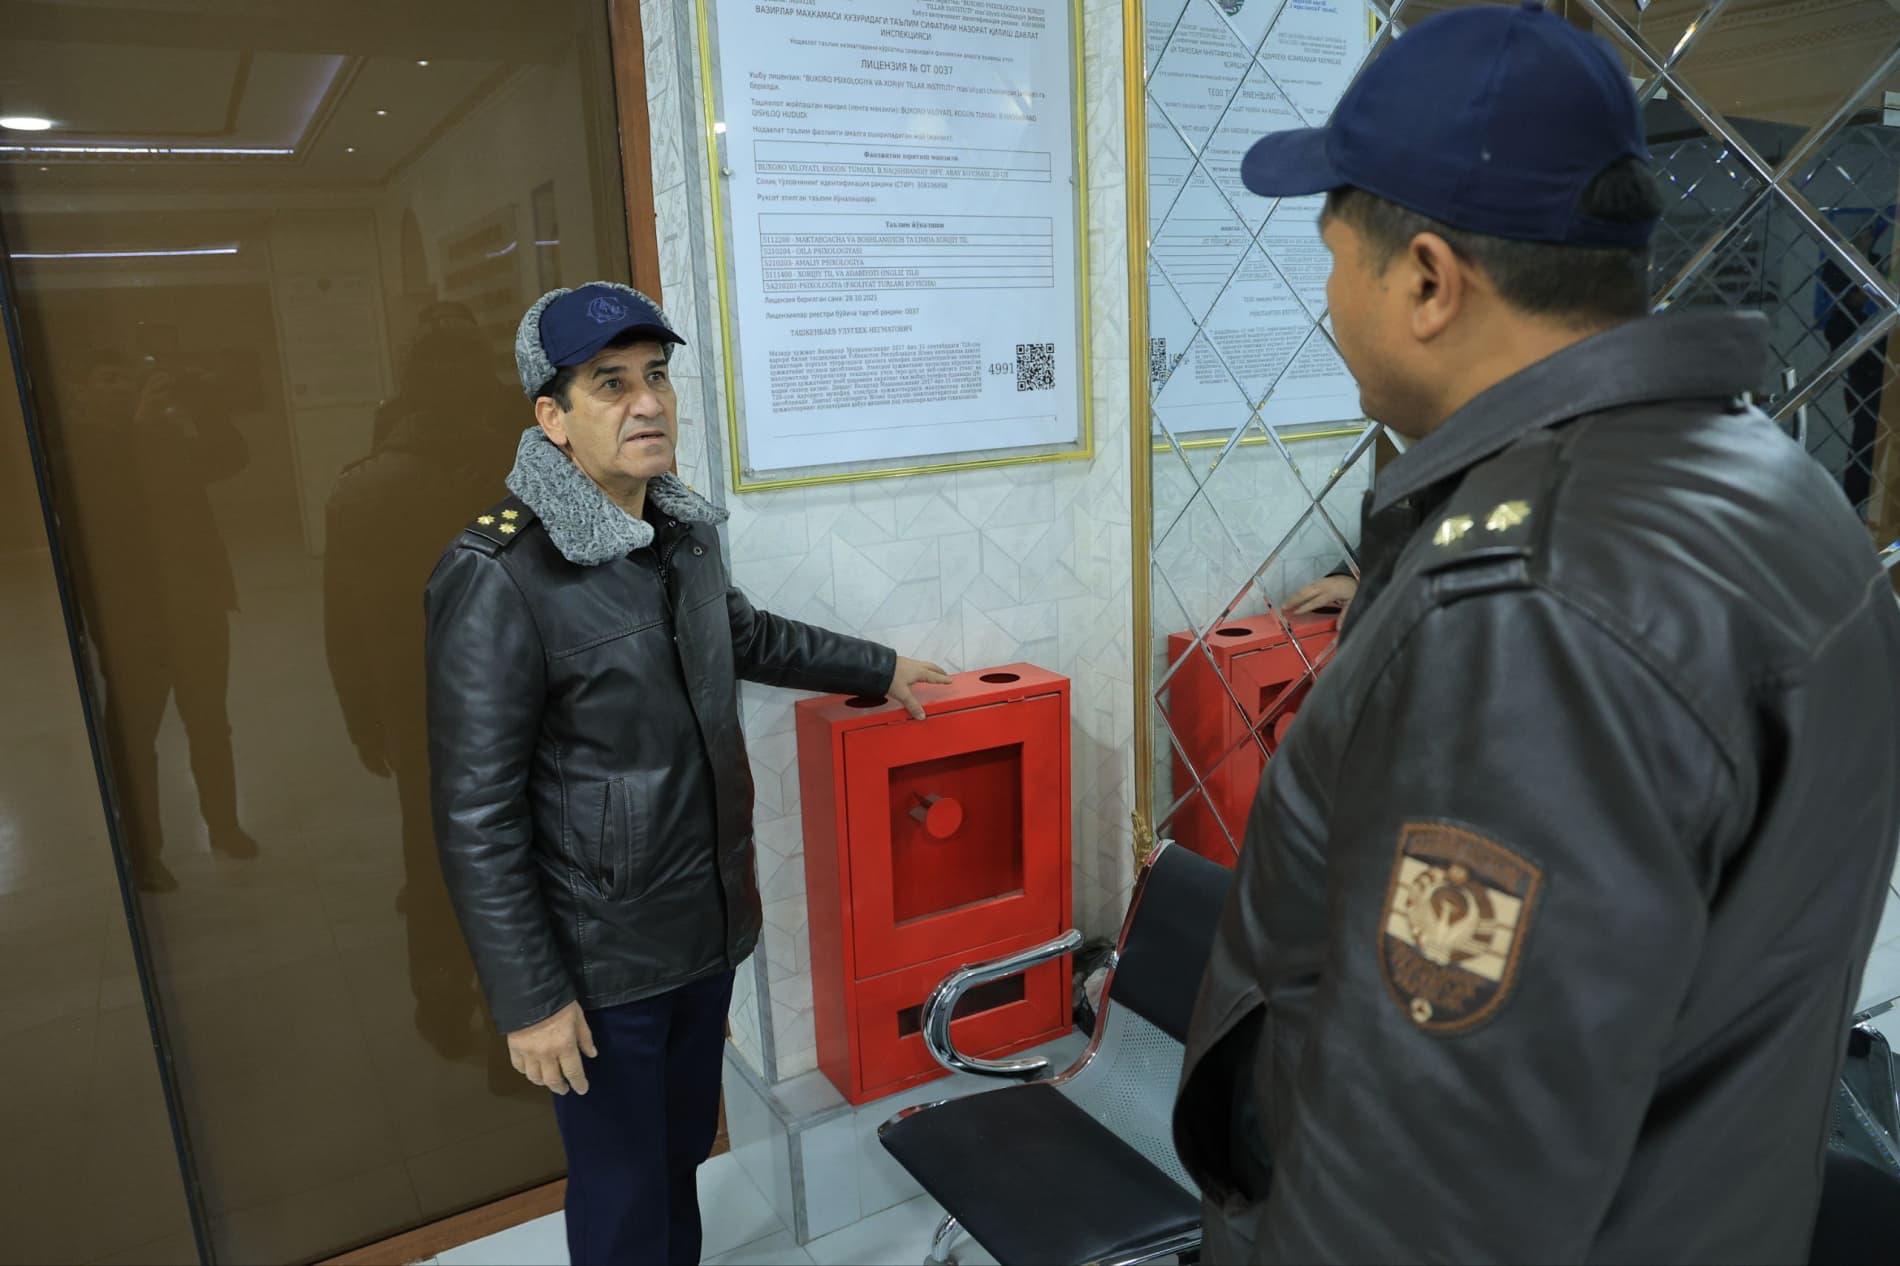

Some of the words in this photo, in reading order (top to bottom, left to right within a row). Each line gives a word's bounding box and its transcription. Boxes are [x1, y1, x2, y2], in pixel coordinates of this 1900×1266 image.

[755, 5, 794, 16] ВАЗИРЛАР
[890, 17, 919, 27] ТАЪЛИМ
[920, 21, 957, 32] СИФАТИНИ
[959, 25, 987, 35] НАЗОРАТ
[1014, 31, 1039, 40] ДАВЛАТ
[880, 29, 932, 41] ИНСПЕКЦИЯСИ
[861, 59, 907, 73] ЛИЦЕНЗИЯ
[909, 63, 918, 73] №
[920, 64, 932, 74] ОТ
[933, 65, 953, 76] 0037
[822, 258, 865, 266] PSIXOLOGIYA
[988, 361, 1014, 375] 4991
